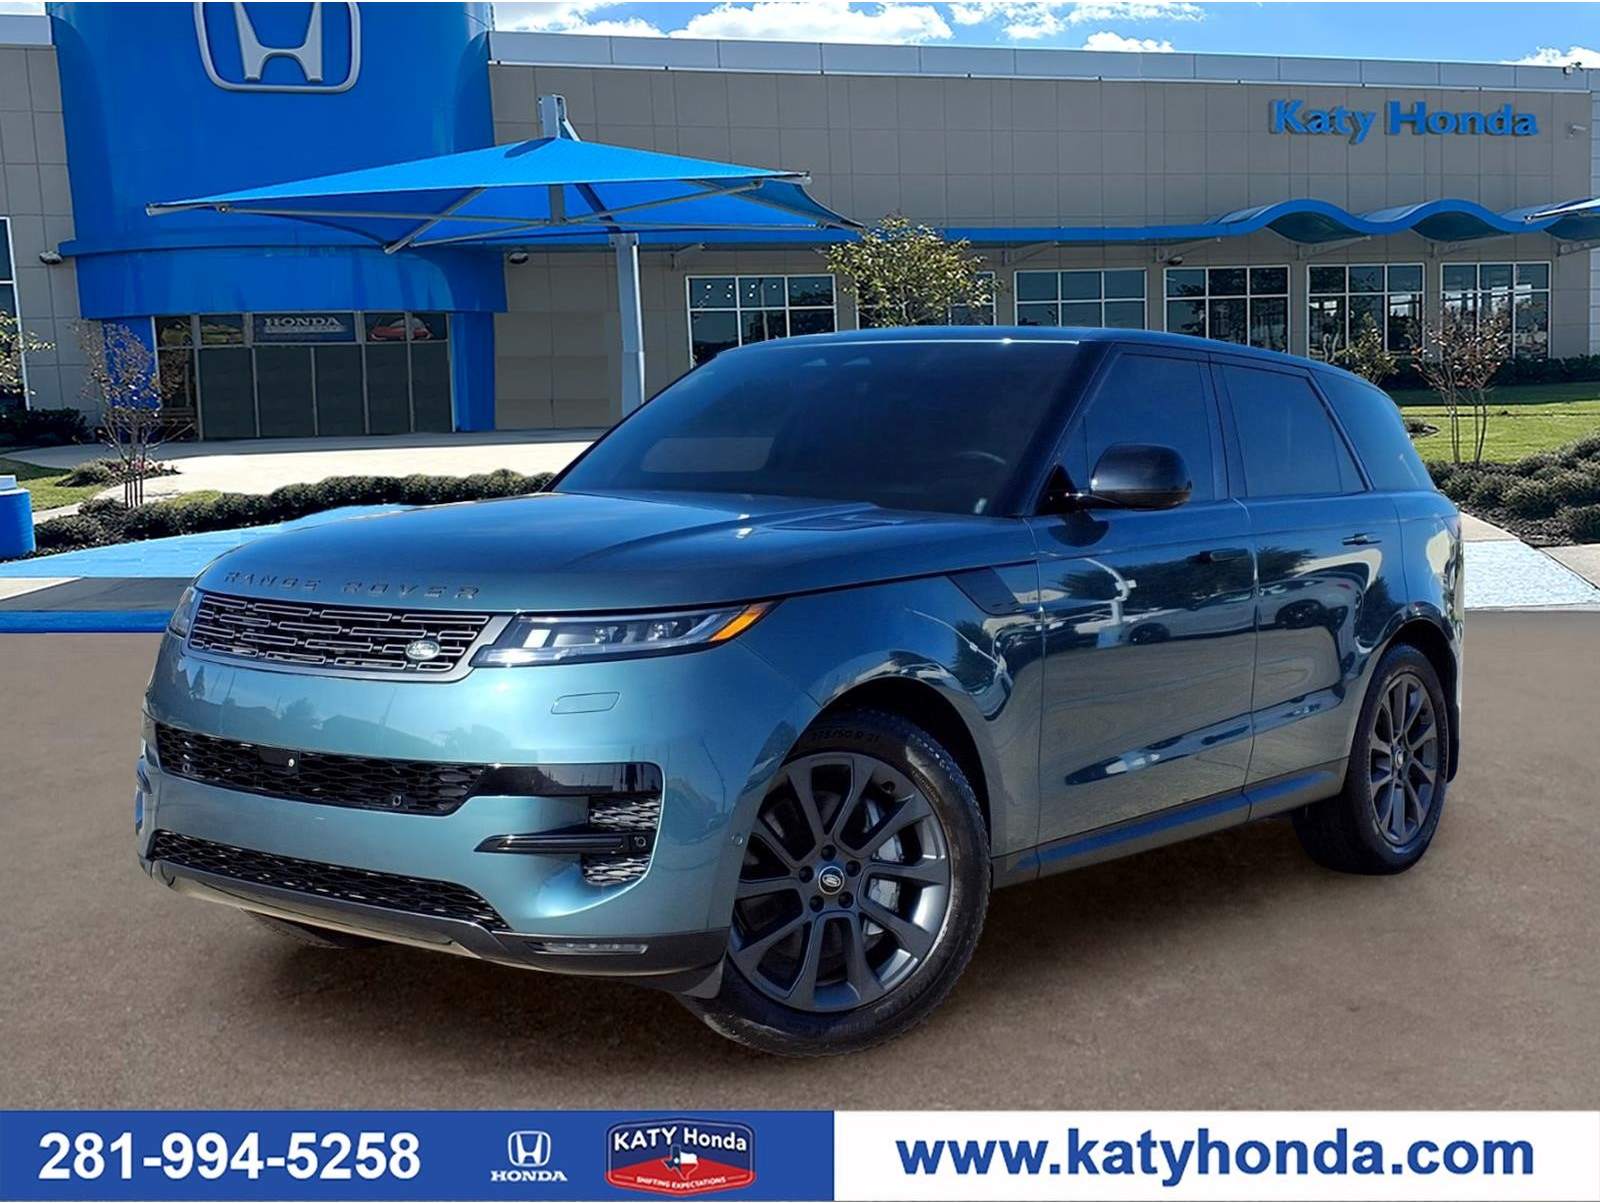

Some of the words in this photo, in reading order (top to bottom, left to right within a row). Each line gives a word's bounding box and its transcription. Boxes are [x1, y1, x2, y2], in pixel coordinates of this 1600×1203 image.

[1270, 99, 1376, 144] Katy
[1385, 101, 1538, 136] Honda
[264, 317, 341, 326] HONDA
[224, 571, 321, 591] RANGE
[343, 579, 480, 600] ROVER
